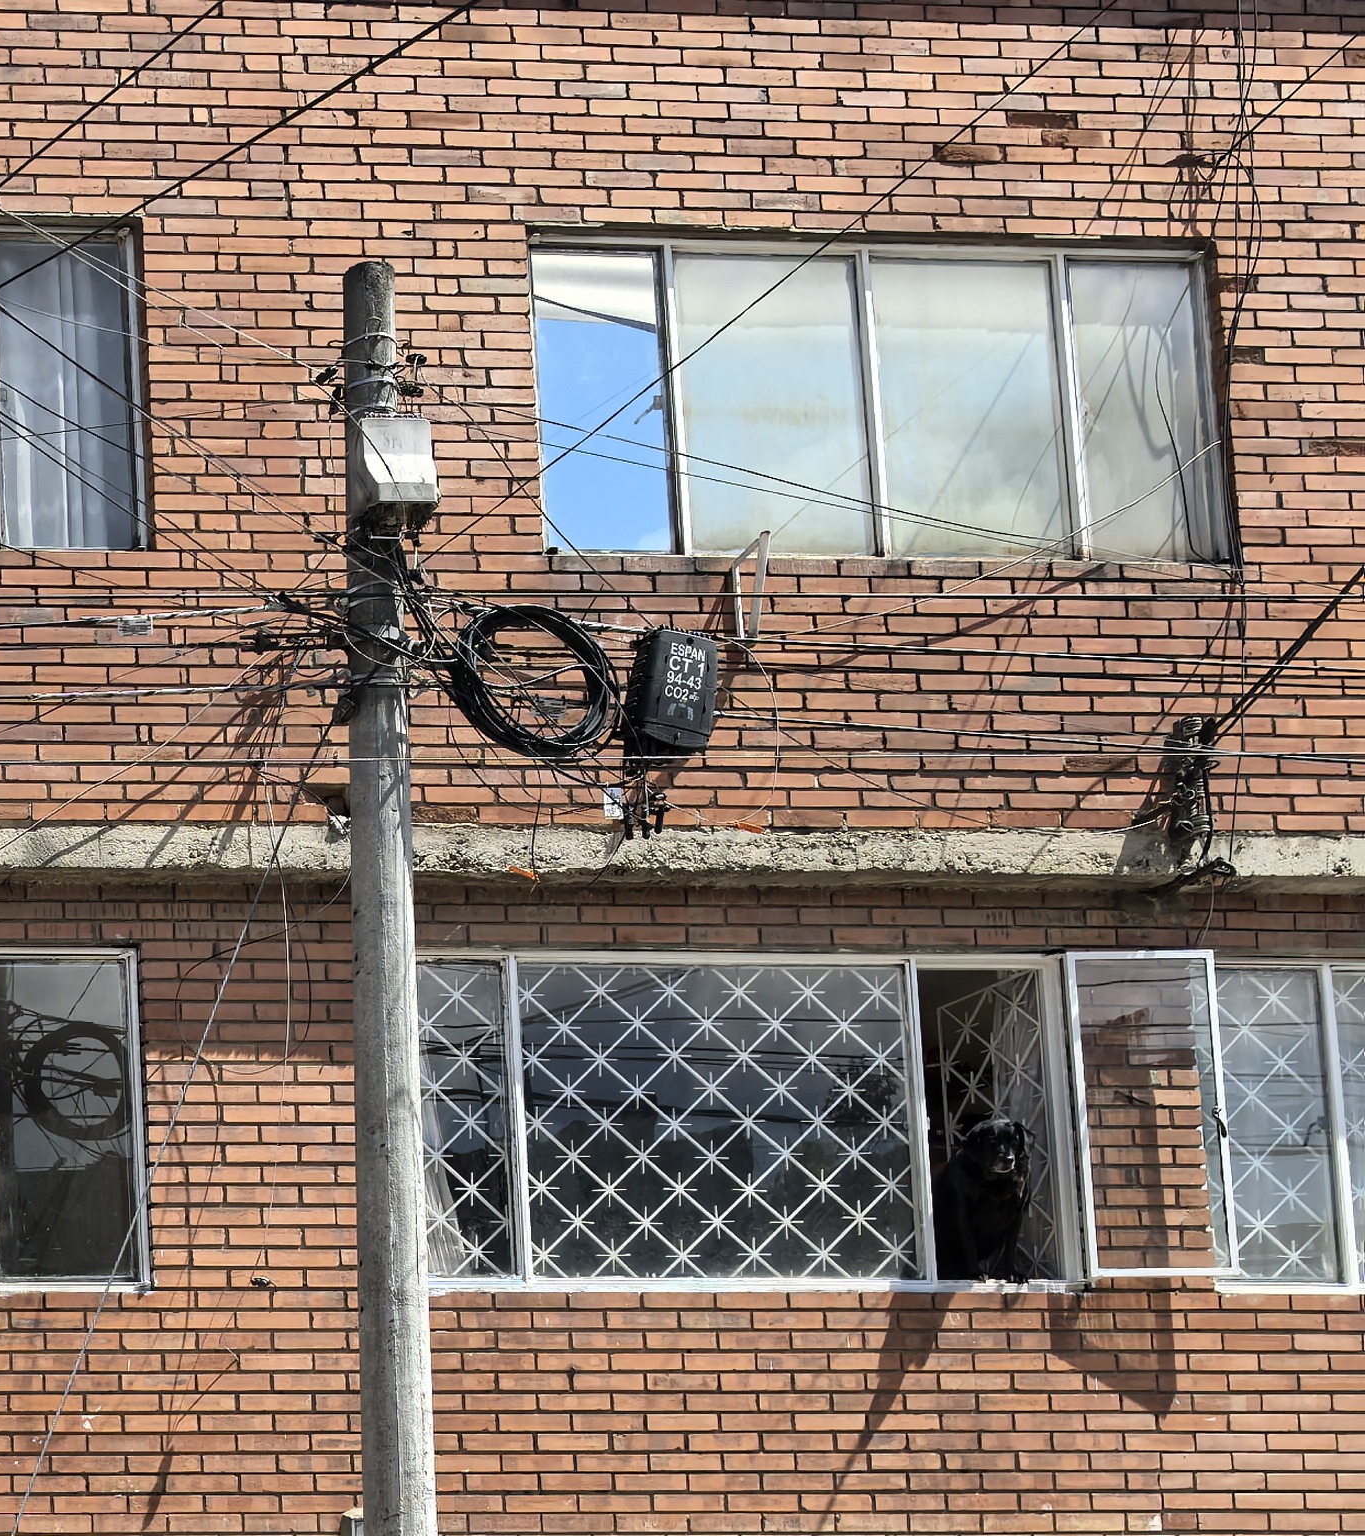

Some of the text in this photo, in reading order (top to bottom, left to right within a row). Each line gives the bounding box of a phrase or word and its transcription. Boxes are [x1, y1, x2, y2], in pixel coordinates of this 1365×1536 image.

[670, 643, 706, 662] ESPAN
[669, 656, 693, 674] CT
[666, 670, 702, 690] 94-43
